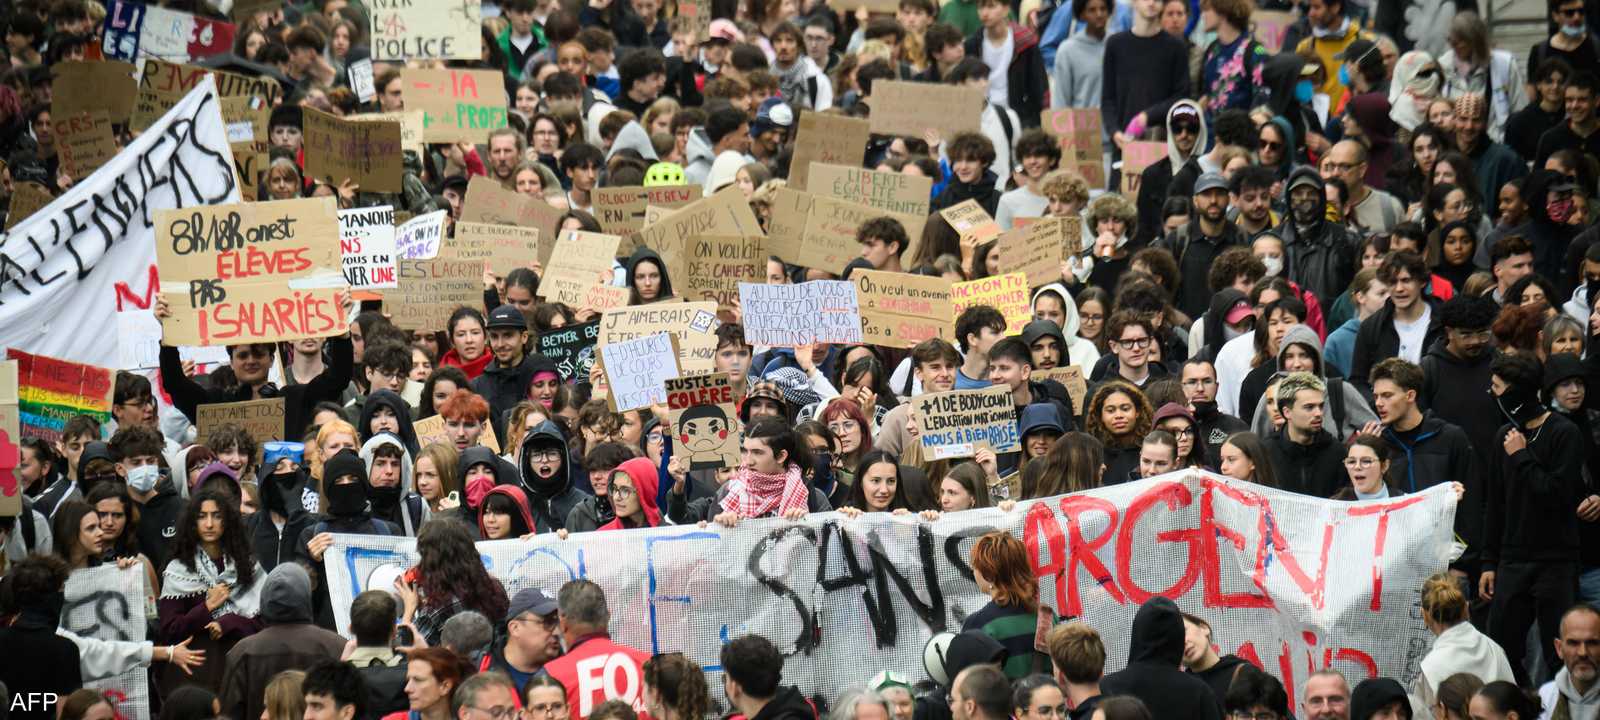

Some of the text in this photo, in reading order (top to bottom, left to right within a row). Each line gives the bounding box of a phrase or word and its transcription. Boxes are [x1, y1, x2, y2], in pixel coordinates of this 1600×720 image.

[375, 36, 455, 58] POLICE
[450, 70, 480, 99] IA
[598, 191, 637, 205] BLOCUS
[604, 209, 623, 224] RN
[695, 241, 713, 258] ON
[372, 254, 389, 264] EN
[371, 266, 395, 284] UNE
[688, 262, 711, 278] DES
[713, 262, 755, 279] CAHIERS
[860, 275, 951, 303] On veut un avenir
[1005, 274, 1023, 289] TU
[190, 279, 226, 309] PAS
[558, 290, 581, 304] NOS
[751, 285, 765, 300] AU
[800, 283, 816, 298] DE
[817, 281, 845, 297] VOUS
[829, 311, 851, 326] NOS
[861, 316, 880, 335] Pas
[542, 330, 579, 347] BETTER
[542, 347, 563, 358] THAN
[664, 374, 714, 392] JUSTE
[667, 383, 732, 411] COLÈRE
[942, 394, 957, 413] DE
[247, 402, 285, 418] TOUS
[922, 431, 954, 447] NOUS
[1022, 476, 1425, 618] ARGENT
[577, 652, 640, 718] FO
